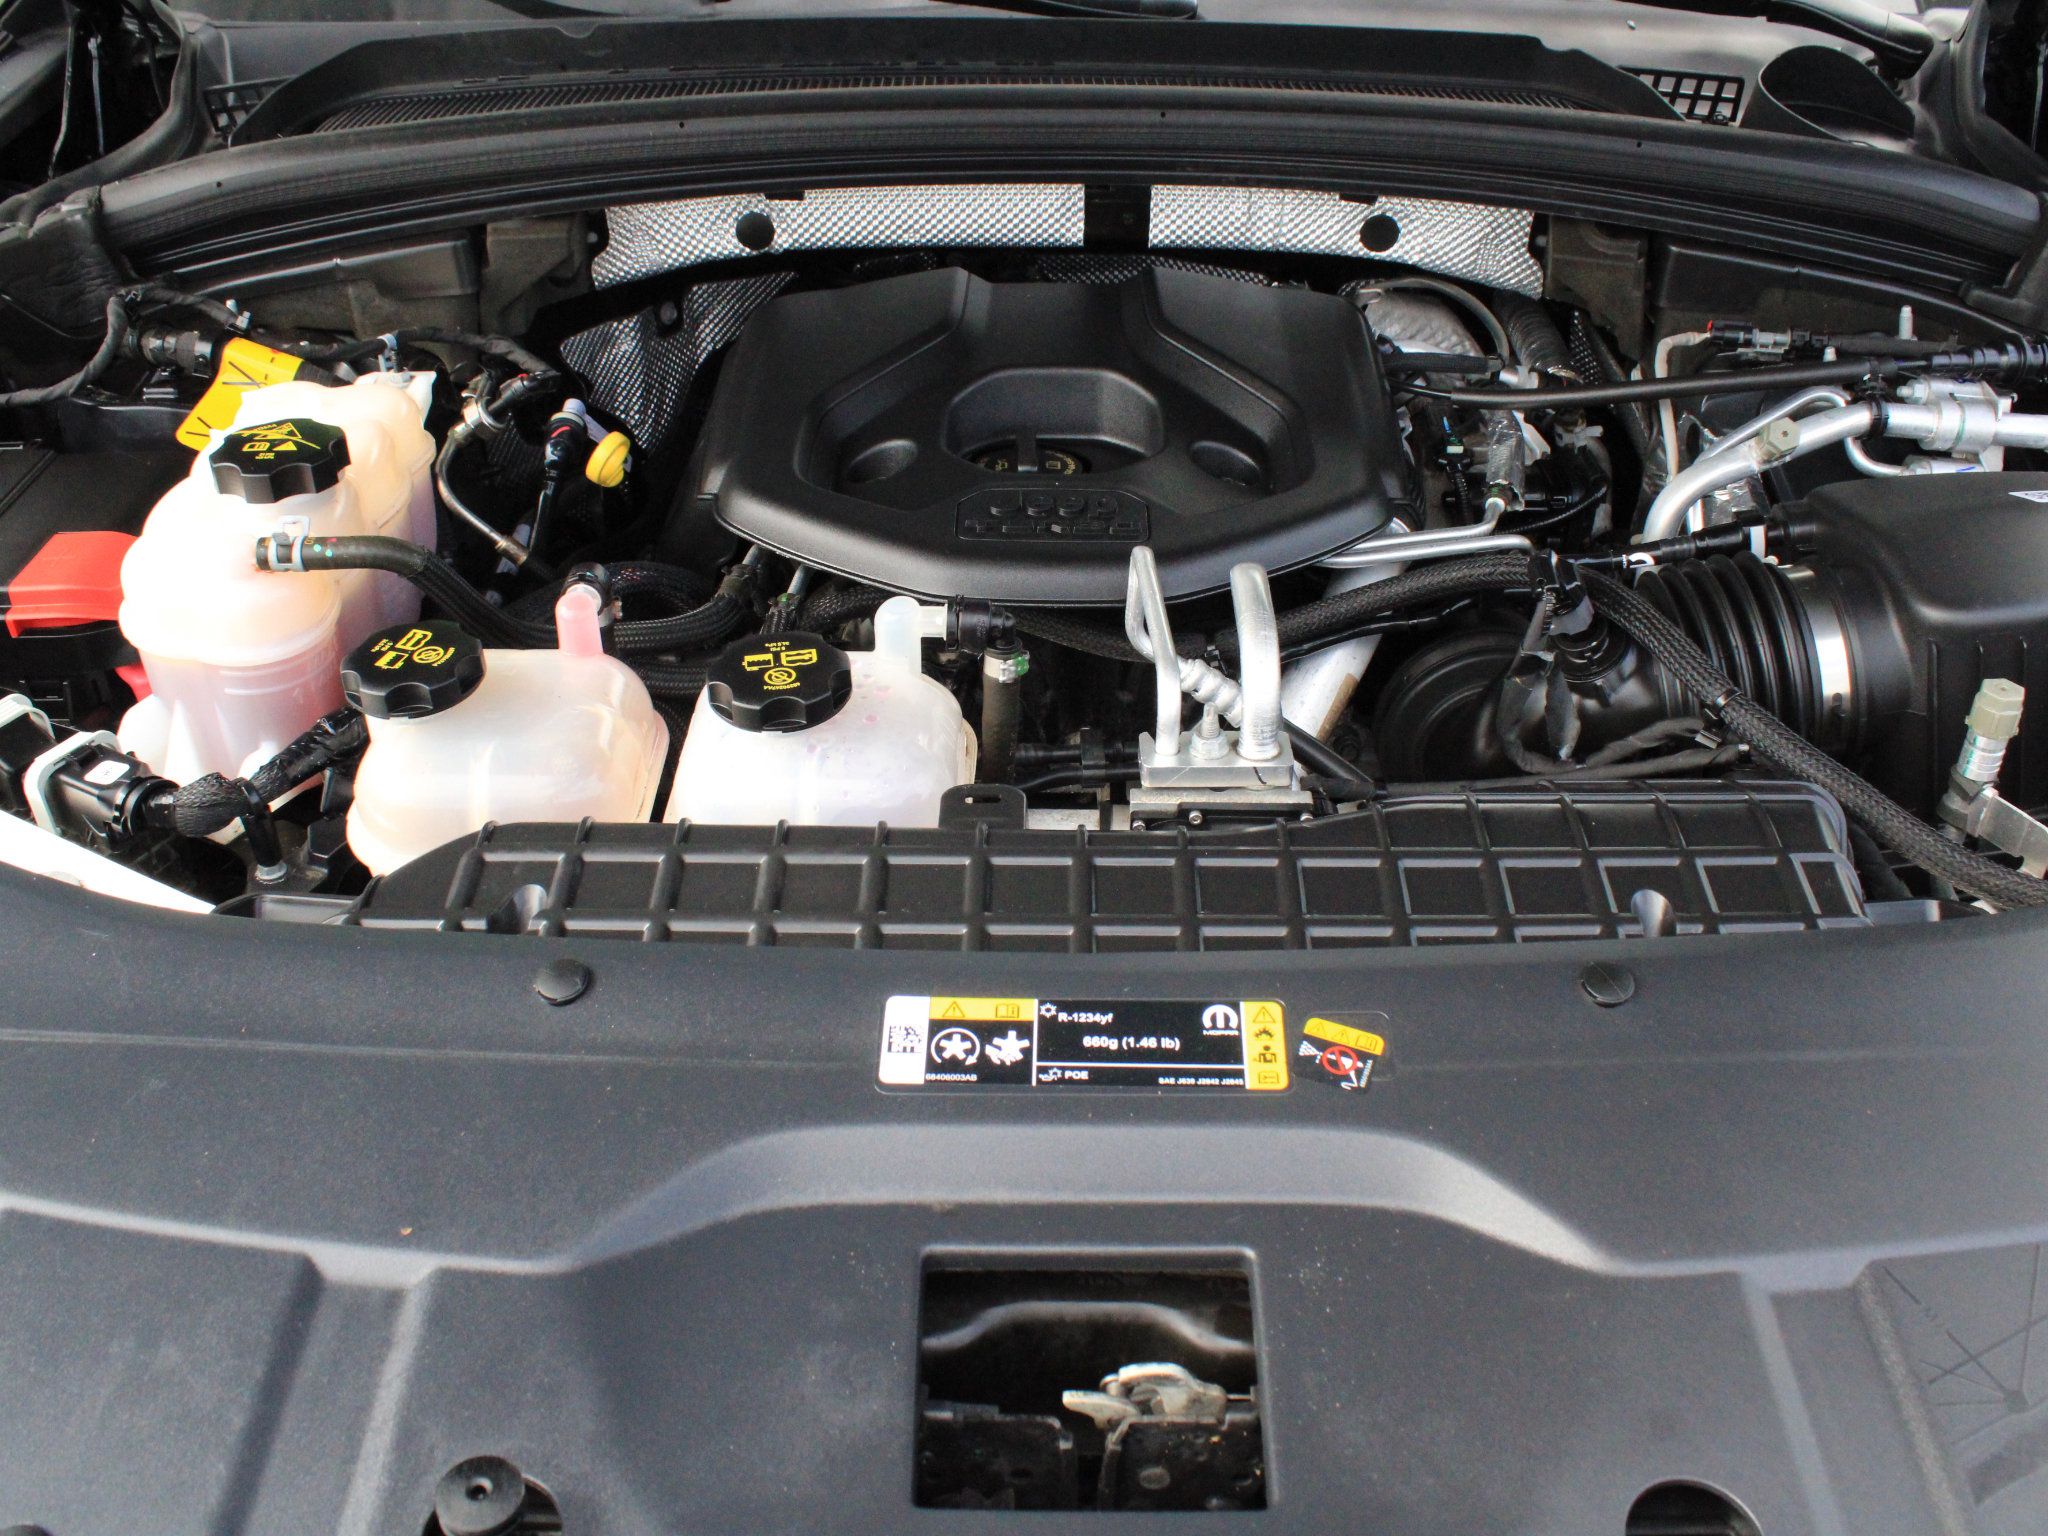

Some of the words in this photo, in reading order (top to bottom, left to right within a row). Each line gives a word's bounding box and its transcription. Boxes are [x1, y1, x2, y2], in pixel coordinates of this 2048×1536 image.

[990, 490, 1118, 517] Jeep
[1058, 1011, 1114, 1026] R-1234yf
[1082, 1035, 1119, 1050] 660g
[1122, 1035, 1158, 1051] (1.46
[1160, 1035, 1181, 1051] lb)
[1064, 1070, 1089, 1080] POE
[1158, 1076, 1175, 1085] SAE
